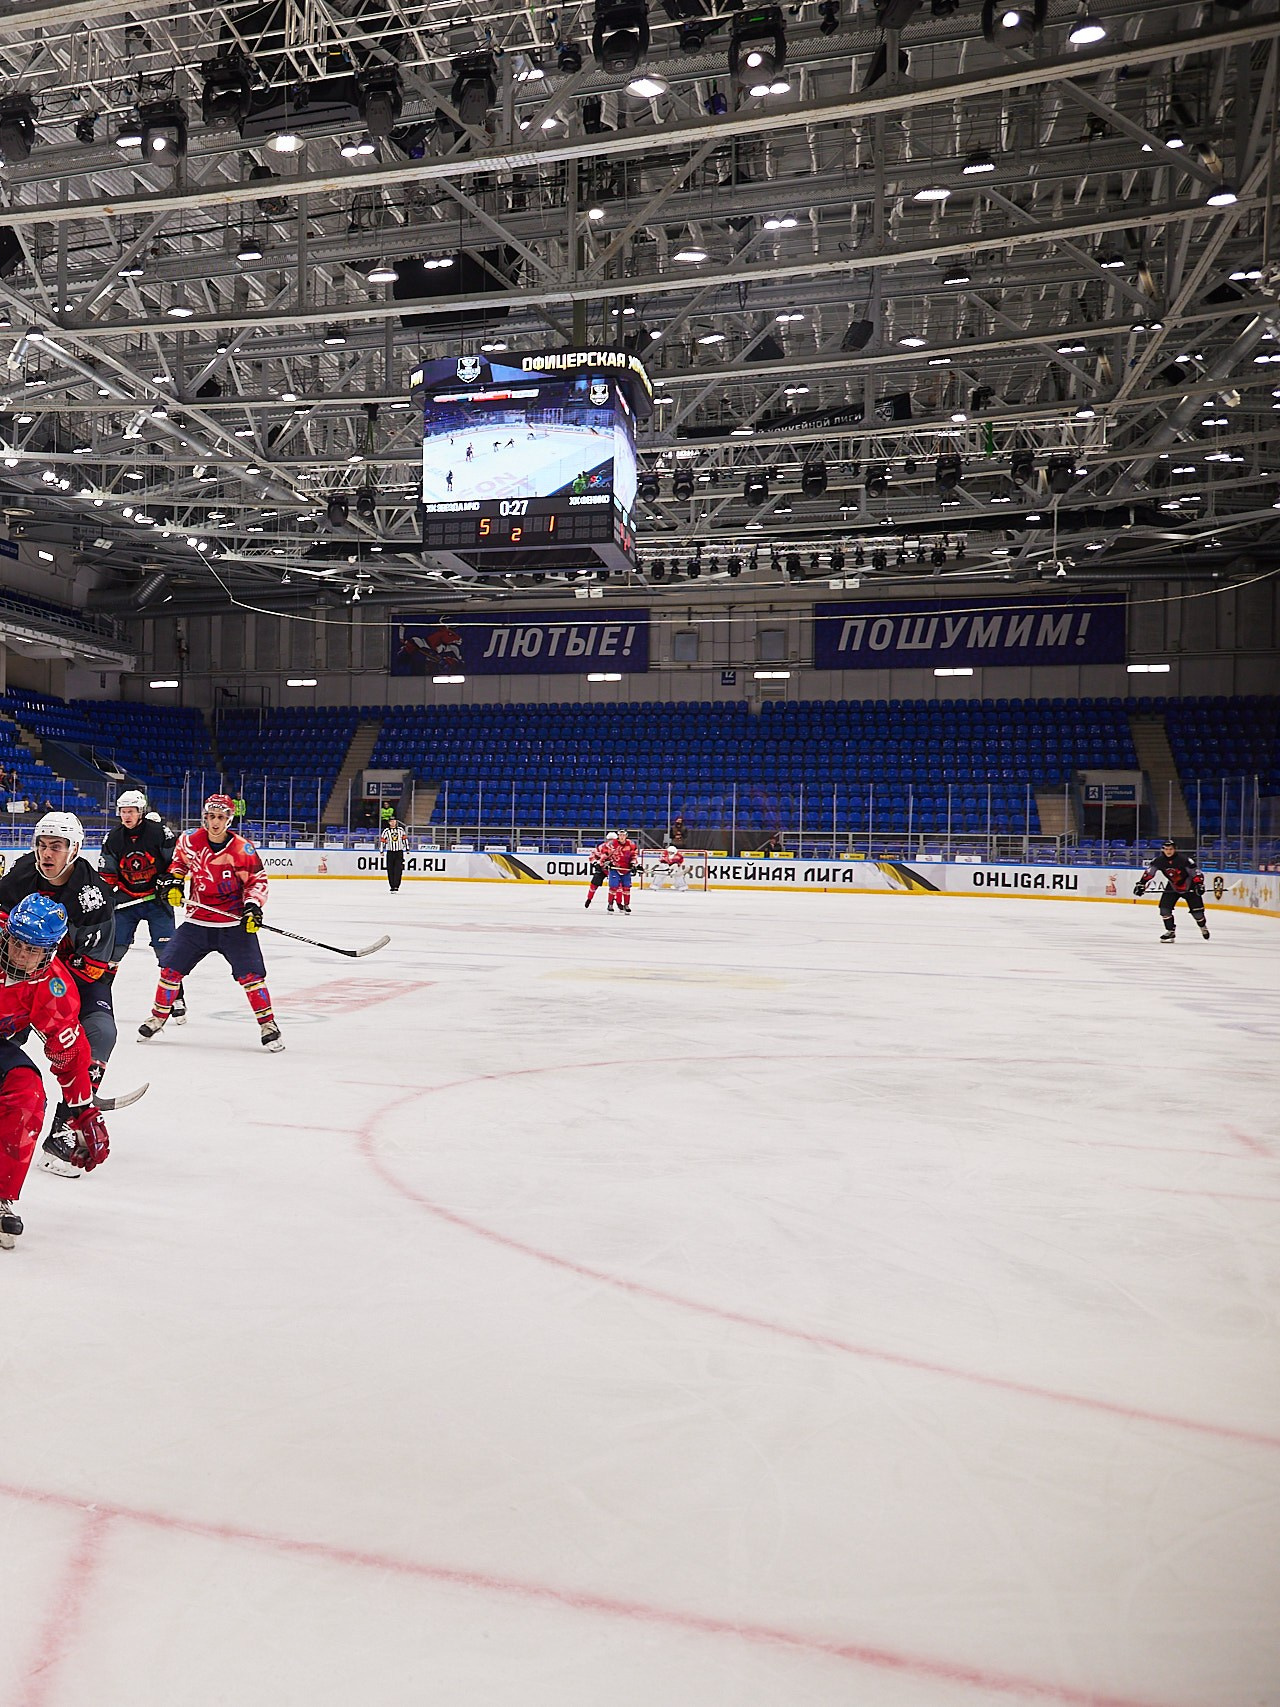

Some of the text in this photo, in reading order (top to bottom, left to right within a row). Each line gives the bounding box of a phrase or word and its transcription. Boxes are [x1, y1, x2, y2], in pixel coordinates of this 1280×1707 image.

[522, 352, 626, 372] ОФИЦЕРСКАЯ
[834, 413, 862, 426] ЛИГИ
[499, 500, 528, 516] 0:27
[480, 518, 491, 536] 5
[548, 515, 555, 532] 1
[511, 528, 522, 542] 2
[837, 612, 1092, 651] ПОШУМИМ!
[482, 626, 636, 658] ЛЮТЫЕ!
[357, 857, 446, 872] OHLA.RU
[803, 867, 853, 883] ЛИГА
[973, 871, 1078, 890] OHLIGA.RU
